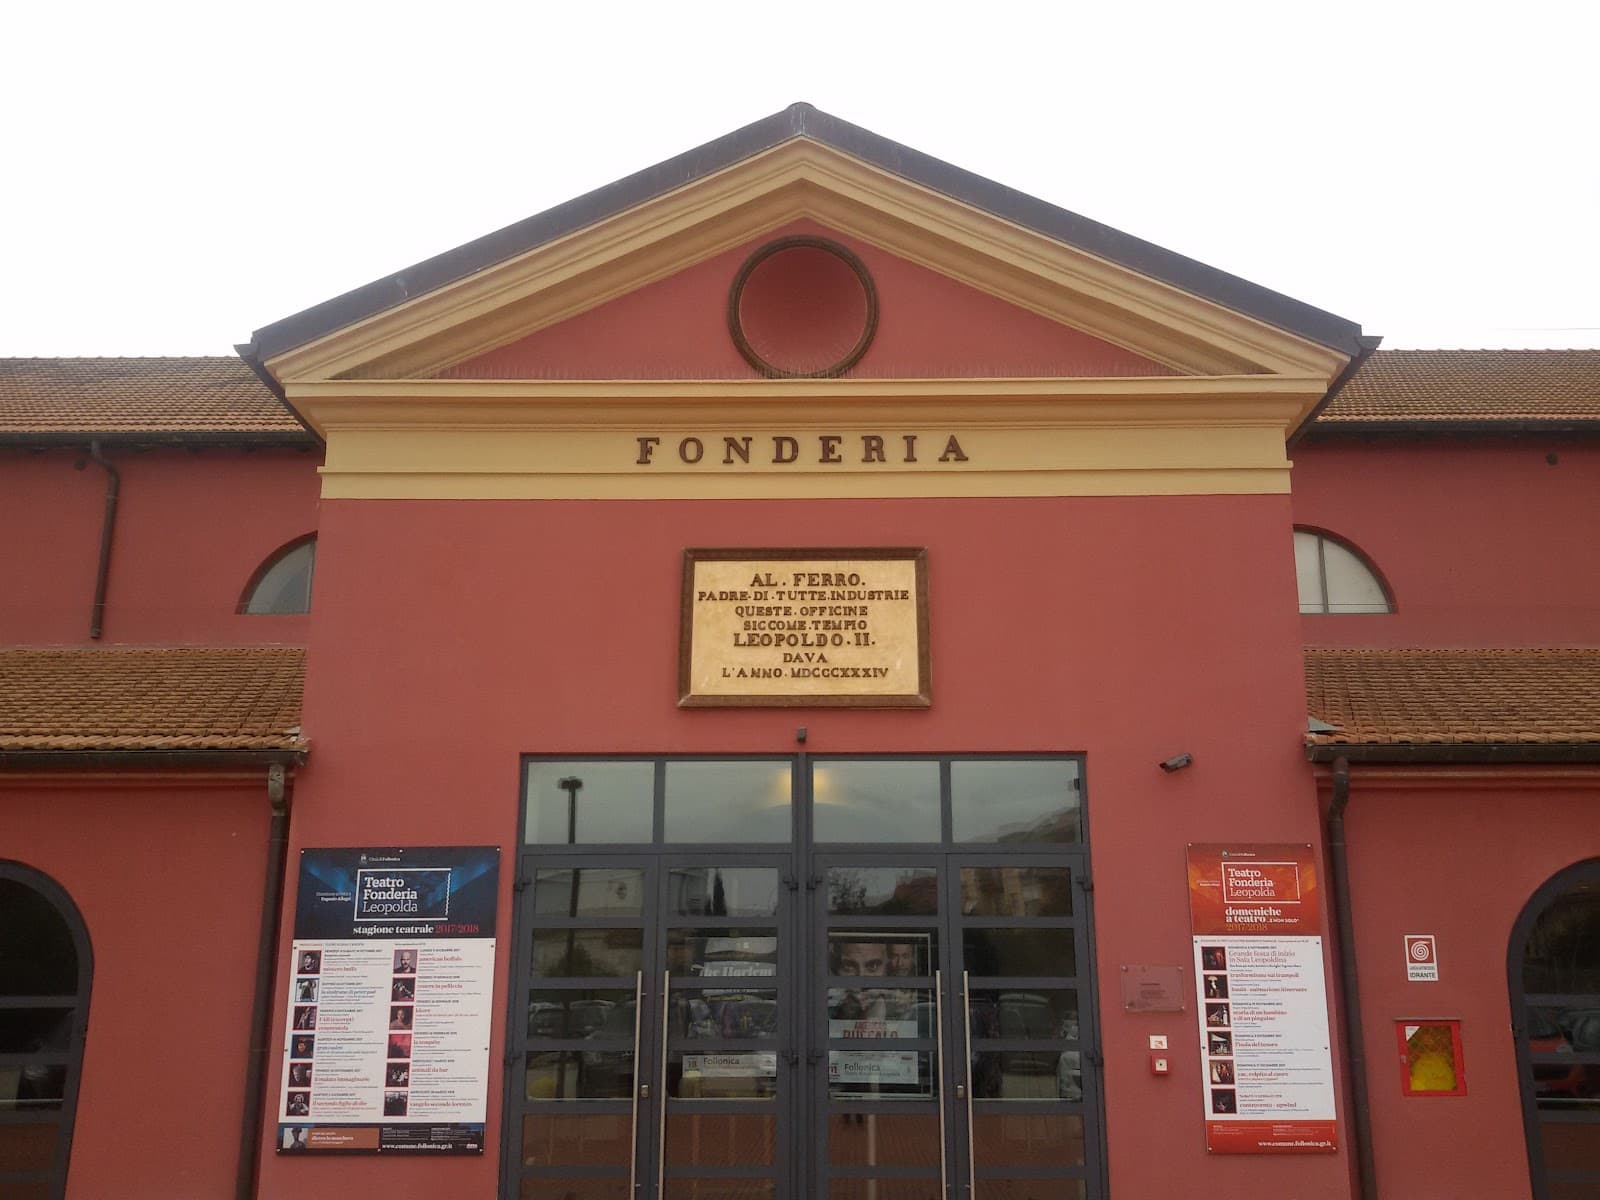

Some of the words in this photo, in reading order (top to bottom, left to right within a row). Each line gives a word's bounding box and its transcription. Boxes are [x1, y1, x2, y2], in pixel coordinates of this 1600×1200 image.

[636, 435, 969, 465] FONDERIA
[830, 589, 909, 600] INDUSTRIE
[799, 606, 868, 616] OFFICINE
[812, 620, 868, 630] TEMPIO
[783, 652, 828, 663] DAVA
[790, 667, 889, 678] MDCCCXXXIV
[1228, 868, 1261, 877] Teatro
[364, 876, 404, 888] Teatro
[1228, 878, 1274, 887] Fonderia
[363, 888, 418, 900] Fonderia
[1230, 887, 1275, 898] Leopolda
[362, 900, 418, 915] Leopolda
[1225, 906, 1281, 916] domeniche
[1234, 915, 1266, 923] teatro
[353, 925, 394, 936] stagione
[395, 924, 434, 934] teatrale
[704, 1057, 740, 1065] Follonica
[844, 1063, 881, 1073] Follonica
